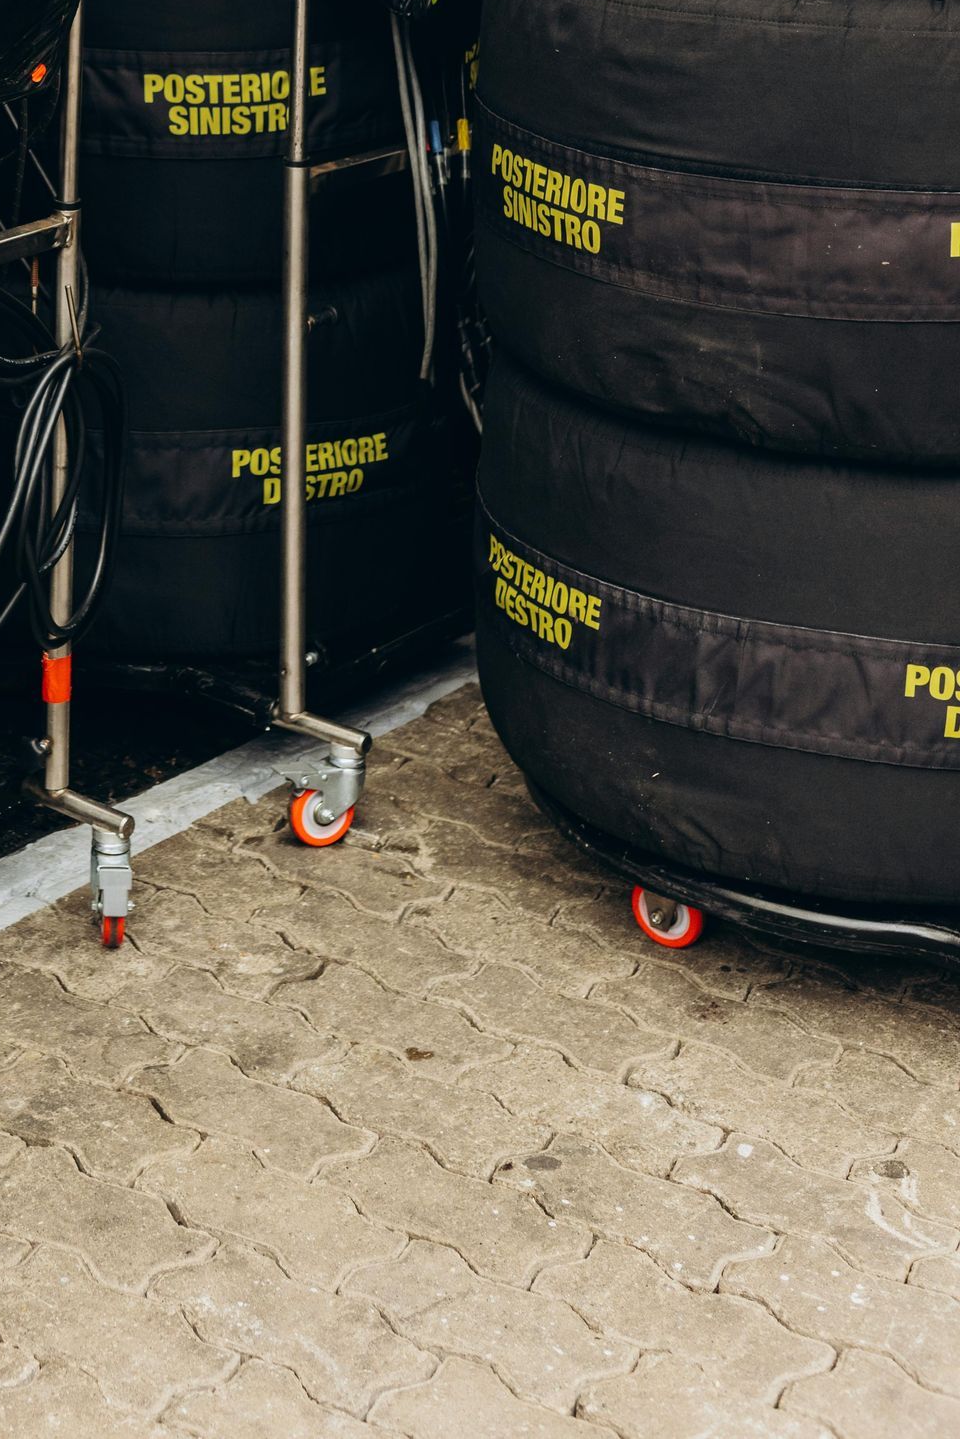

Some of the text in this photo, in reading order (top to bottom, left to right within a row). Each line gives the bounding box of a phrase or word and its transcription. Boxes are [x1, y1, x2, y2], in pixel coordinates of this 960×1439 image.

[144, 66, 327, 104] POSTERIOE
[168, 103, 289, 136] SINISTR
[492, 144, 625, 225] POSTERIORE
[503, 187, 601, 254] SINISTRO
[232, 432, 389, 478] POSERIORE
[263, 468, 364, 505] DSTRO
[489, 534, 601, 630] POSTERIORE
[495, 577, 574, 650] DESTRO
